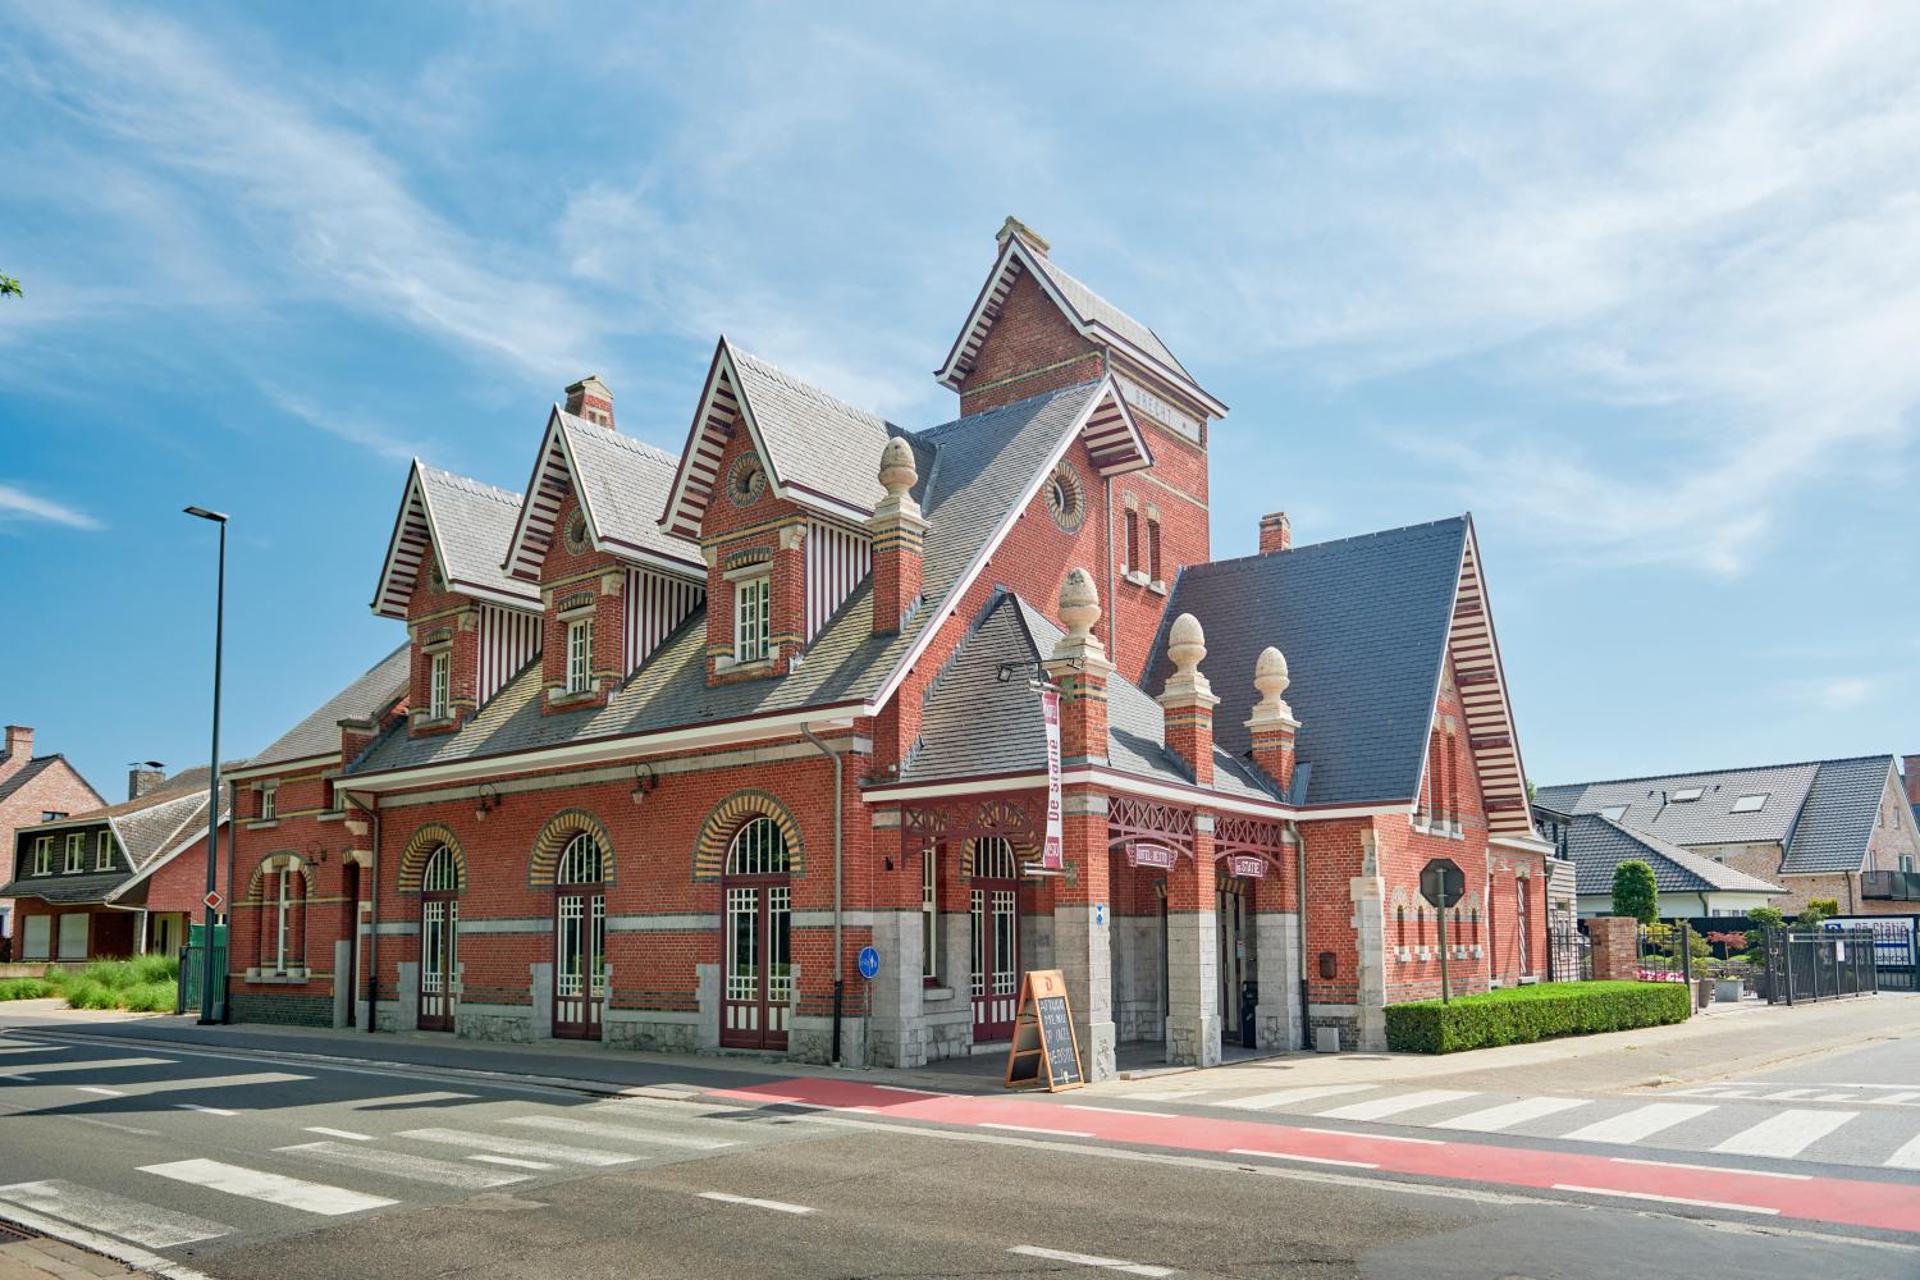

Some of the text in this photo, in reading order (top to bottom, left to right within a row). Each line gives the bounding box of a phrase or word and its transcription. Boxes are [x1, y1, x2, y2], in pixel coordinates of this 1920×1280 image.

[1049, 739, 1060, 821] De Statie
[1873, 922, 1908, 938] Statie
